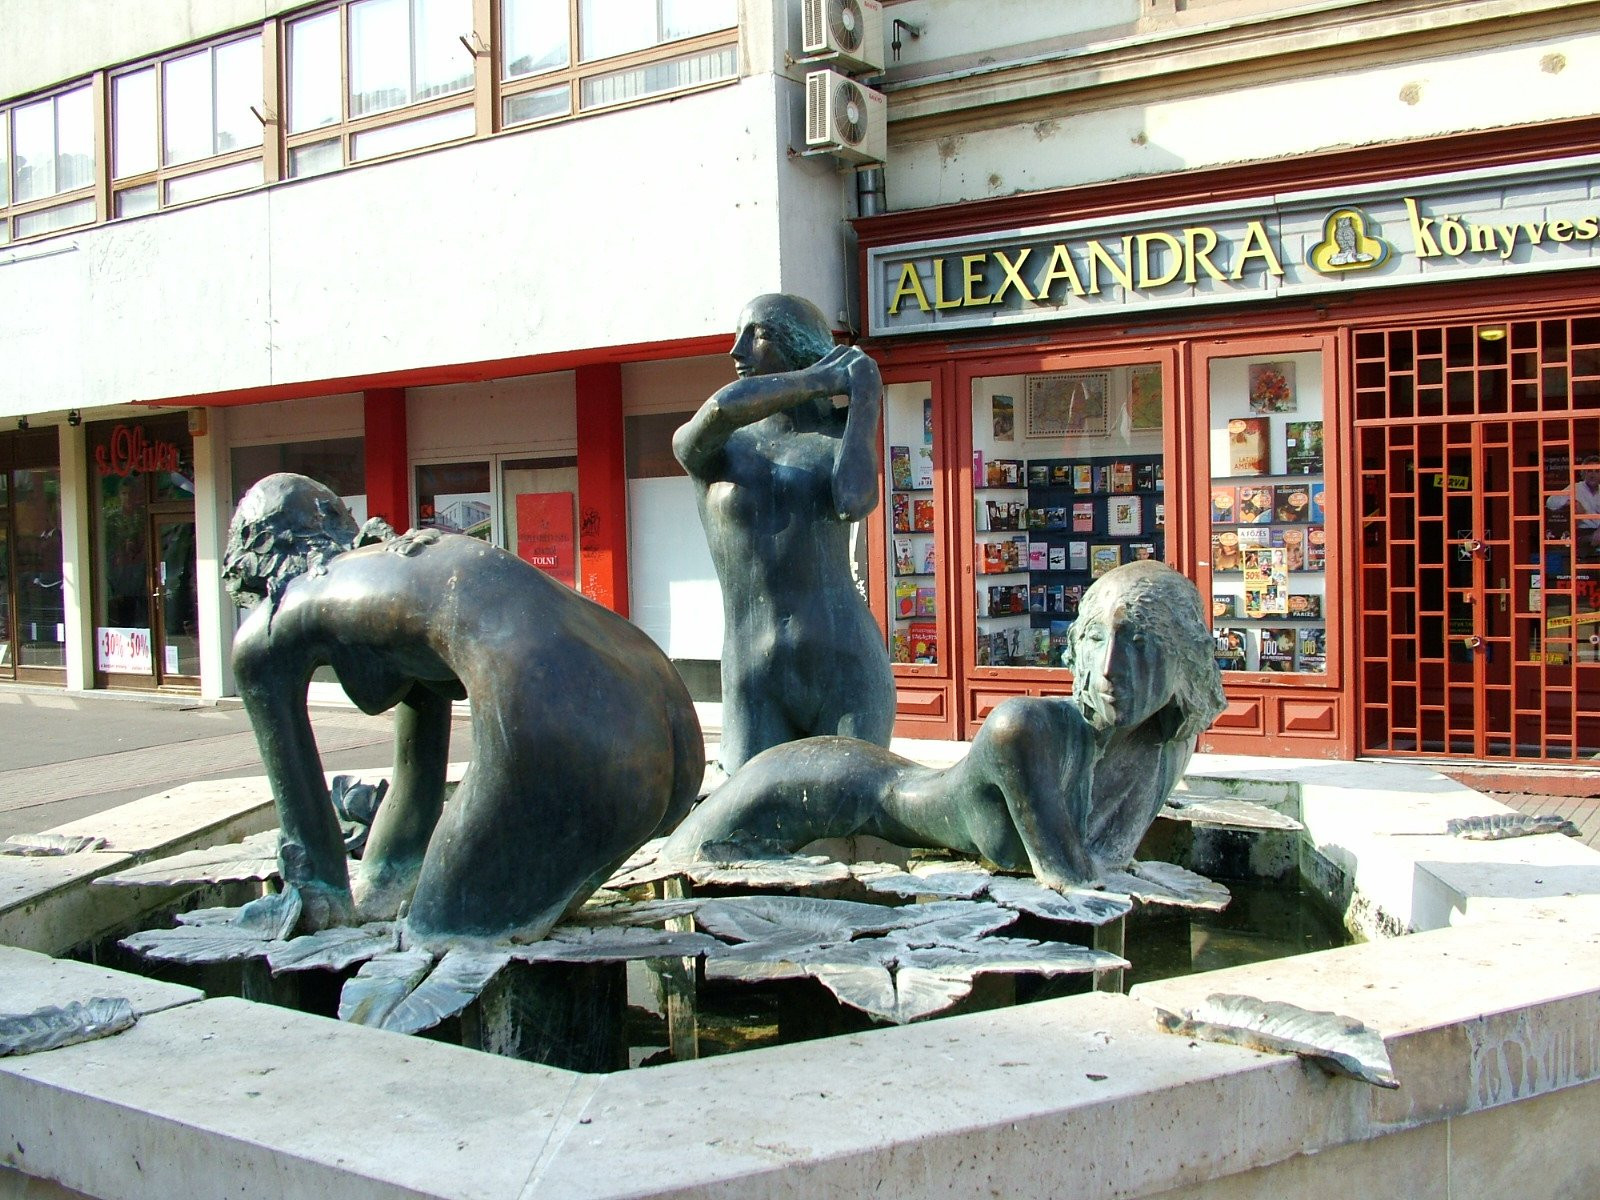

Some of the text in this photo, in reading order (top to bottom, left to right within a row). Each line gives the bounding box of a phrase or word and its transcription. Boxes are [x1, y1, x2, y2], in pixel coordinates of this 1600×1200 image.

[888, 221, 1284, 315] ALEXANDRA
[1436, 477, 1465, 487] ZRVA
[1263, 640, 1277, 655] 100
